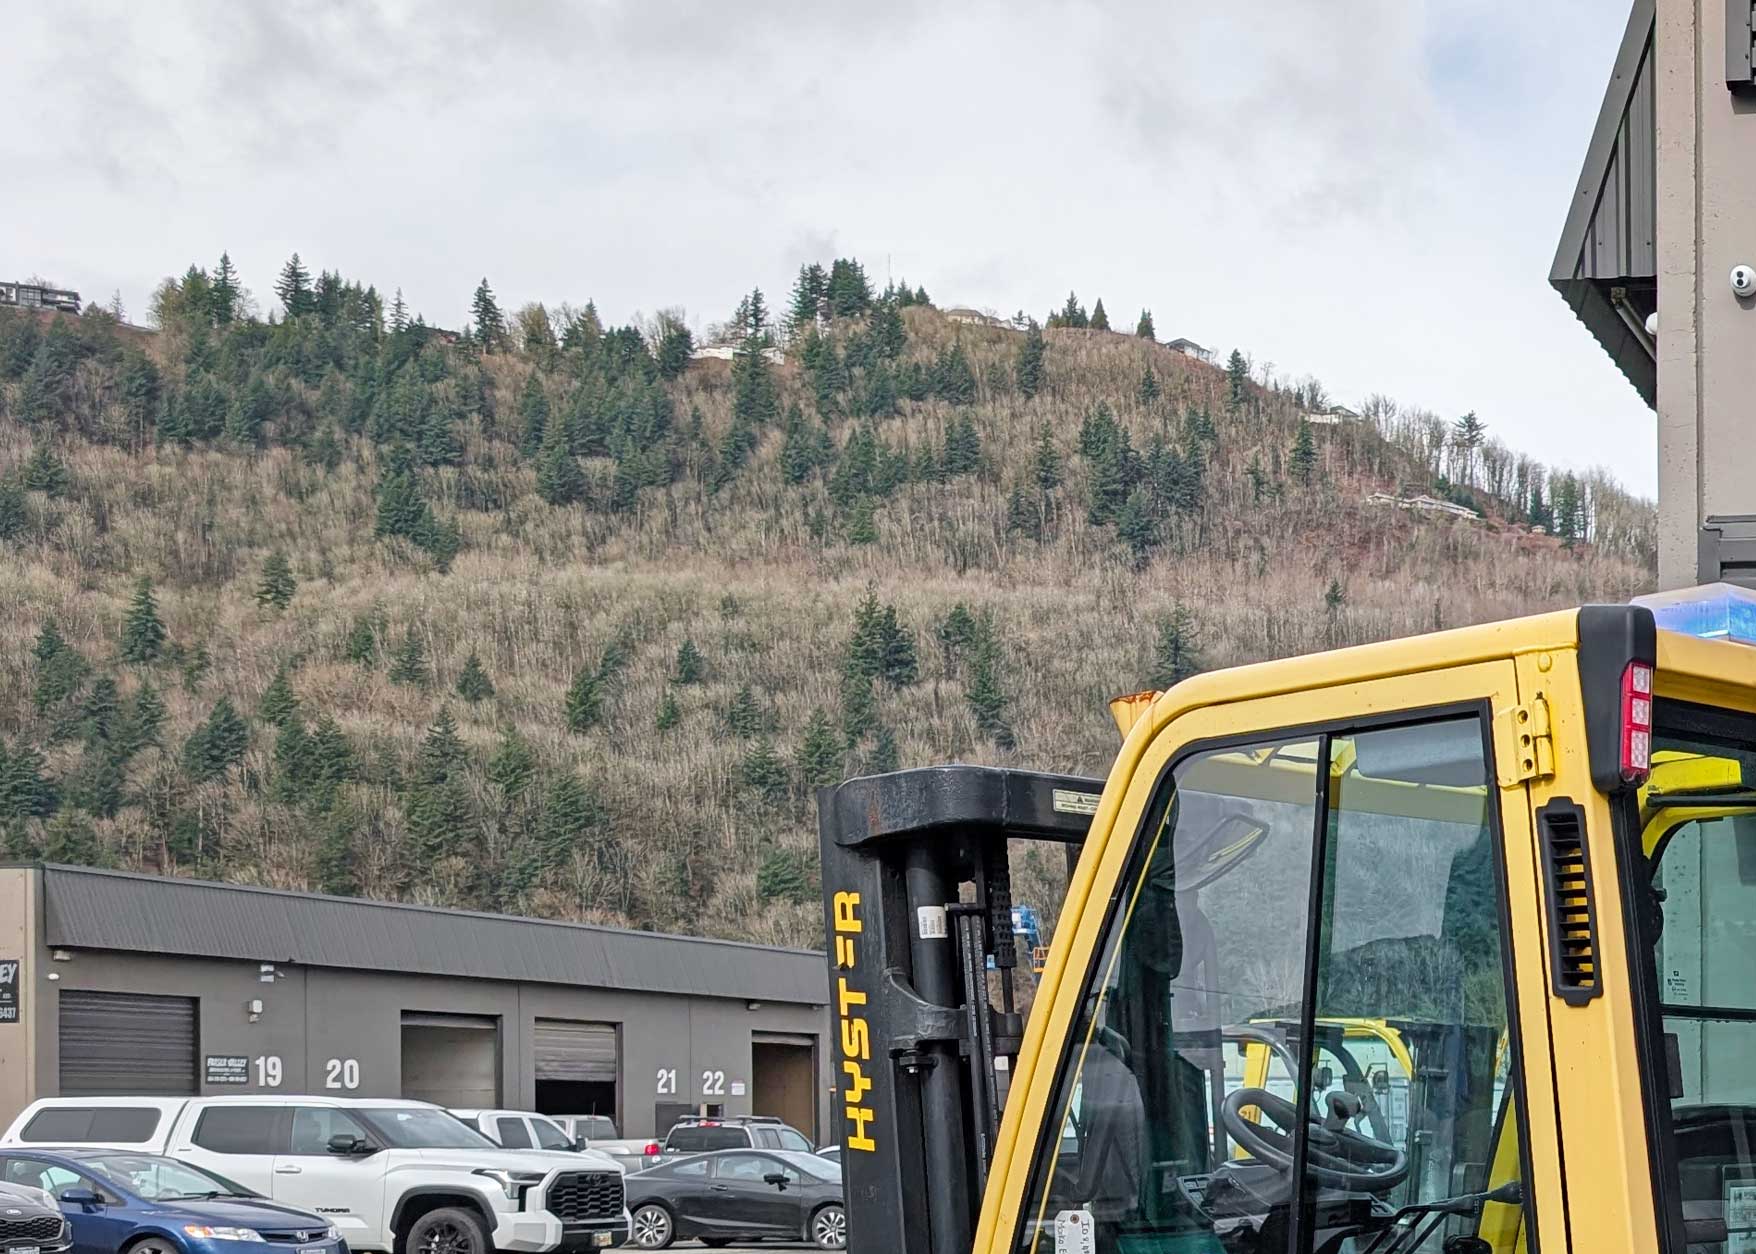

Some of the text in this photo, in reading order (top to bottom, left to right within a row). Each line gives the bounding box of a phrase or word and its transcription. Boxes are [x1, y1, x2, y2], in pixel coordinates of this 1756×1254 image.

[255, 1055, 283, 1087] 19
[326, 1058, 360, 1089] 20
[656, 1068, 676, 1093] 21
[702, 1070, 725, 1095] 22
